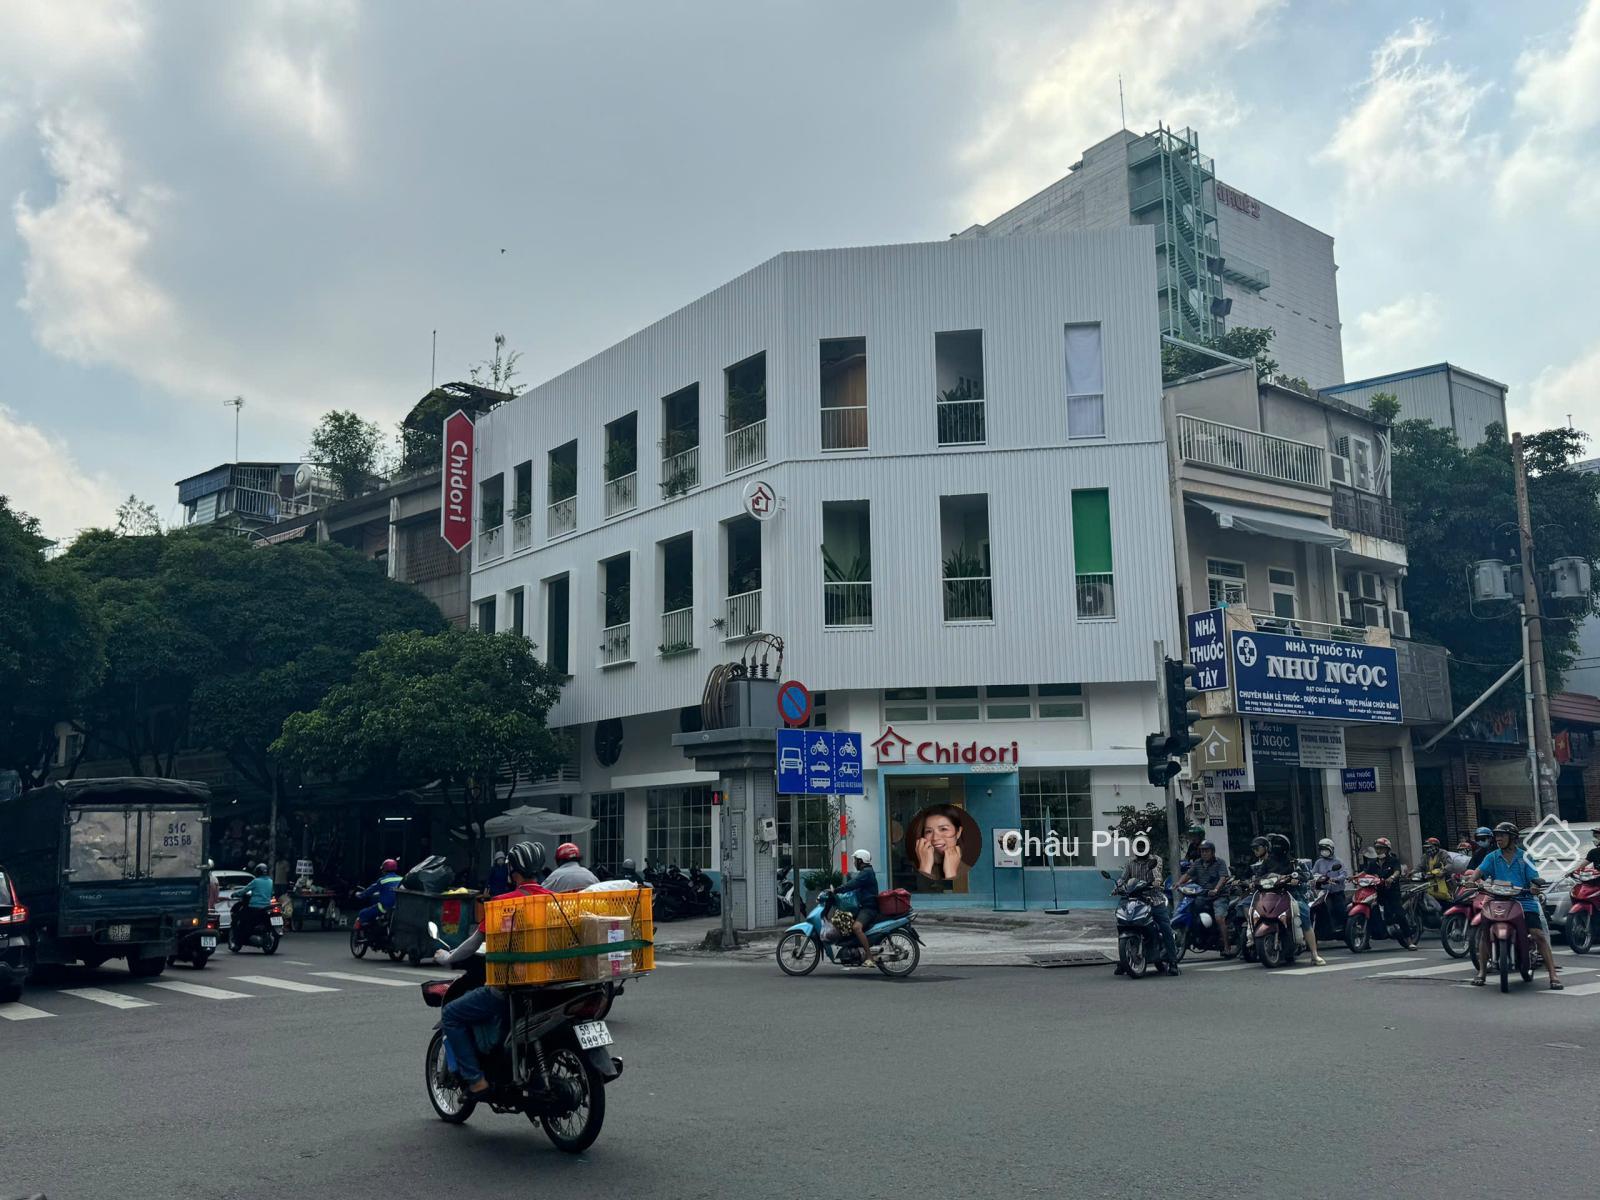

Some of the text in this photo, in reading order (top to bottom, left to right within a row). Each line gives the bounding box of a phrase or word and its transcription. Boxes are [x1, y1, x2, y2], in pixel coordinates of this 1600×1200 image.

[449, 440, 468, 522] Chidori
[1195, 613, 1216, 637] NHÀ
[1190, 636, 1223, 663] THUỐC
[1285, 640, 1363, 659] NHÀ THUỐC TÂY
[1198, 666, 1218, 688] TÂY
[1265, 655, 1388, 691] NHƯ NGỌC
[1262, 690, 1274, 700] BÁN
[1282, 691, 1300, 702] THUỐC
[1327, 694, 1342, 705] PHẨM
[1359, 697, 1372, 707] PHẨM
[1262, 734, 1291, 750] NGỌC
[916, 741, 1018, 765] Chidori
[1222, 779, 1241, 790] NHA
[1358, 780, 1375, 791] NGỌC
[168, 823, 186, 834] 51C
